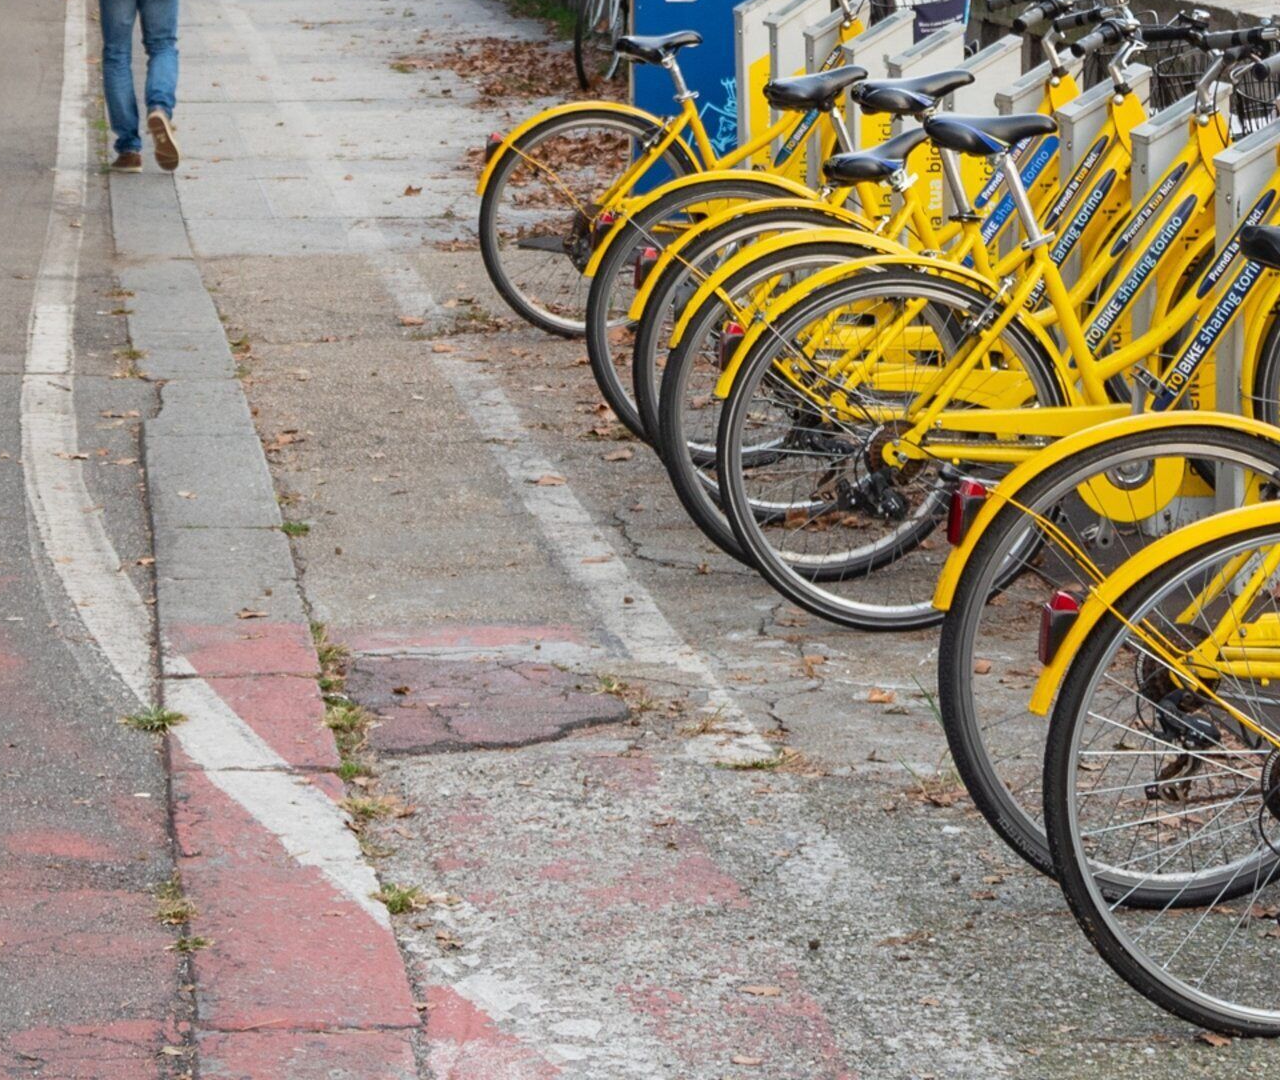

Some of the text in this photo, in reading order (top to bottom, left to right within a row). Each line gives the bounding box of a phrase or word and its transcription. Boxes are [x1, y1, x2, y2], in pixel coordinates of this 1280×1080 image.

[981, 171, 1005, 201] Prendi
[1022, 151, 1049, 186] torino
[928, 179, 942, 210] tua
[1052, 188, 1073, 216] Prendi
[1075, 168, 1089, 183] tua
[1073, 189, 1104, 227] torino
[1122, 213, 1145, 244] Prendi
[1149, 193, 1163, 210] tua
[1159, 179, 1177, 197] bici.
[1118, 254, 1157, 303] sharing
[1151, 215, 1183, 256] torino
[1208, 250, 1232, 282] Prendi
[1200, 292, 1242, 345] sharing
